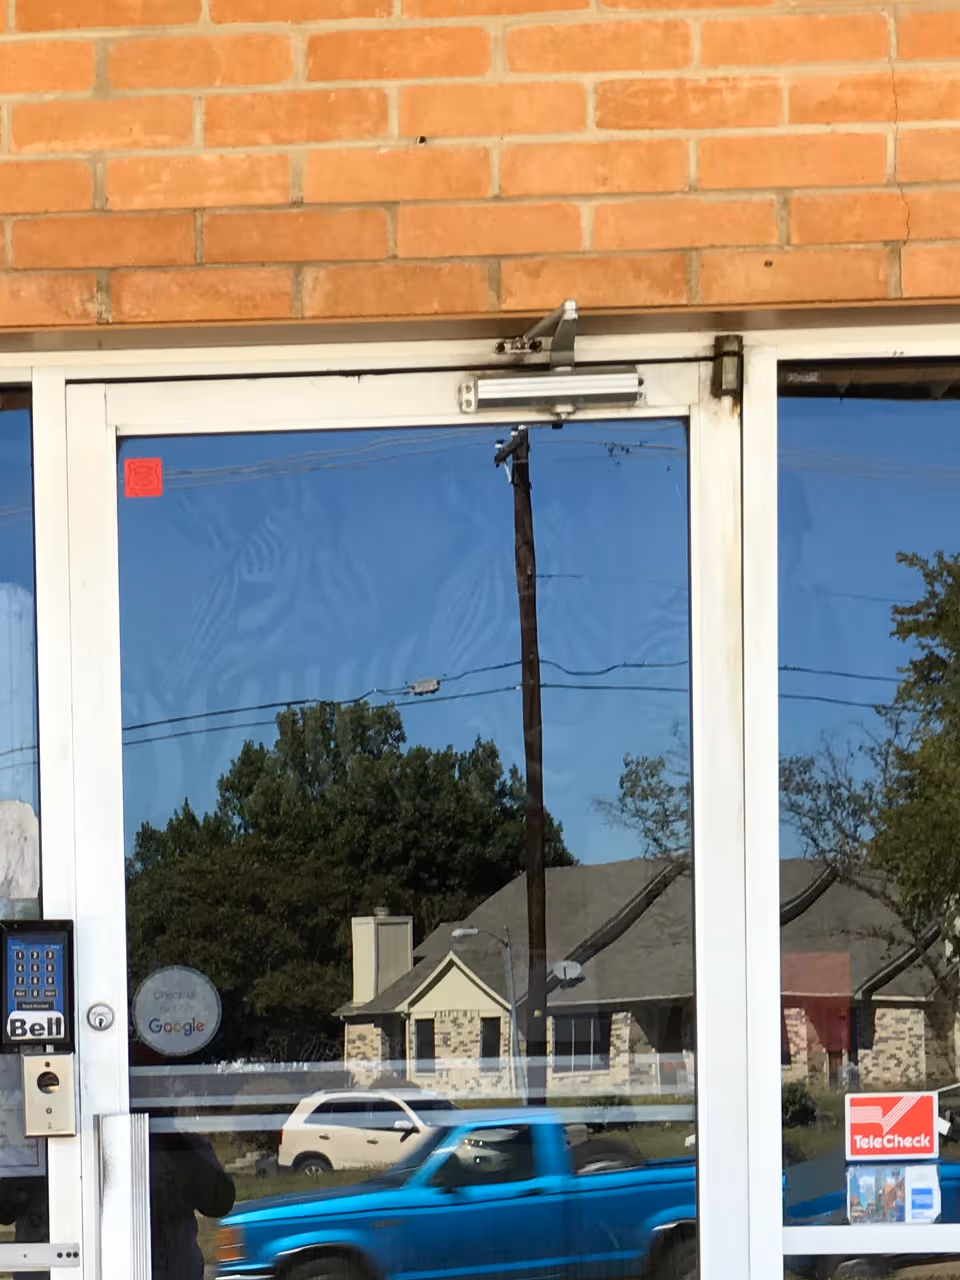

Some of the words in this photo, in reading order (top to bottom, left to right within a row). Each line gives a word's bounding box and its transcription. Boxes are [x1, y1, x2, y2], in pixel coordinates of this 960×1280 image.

[9, 1016, 62, 1038] Bell
[148, 1018, 205, 1037] Google
[854, 1134, 931, 1149] TeleCheck
